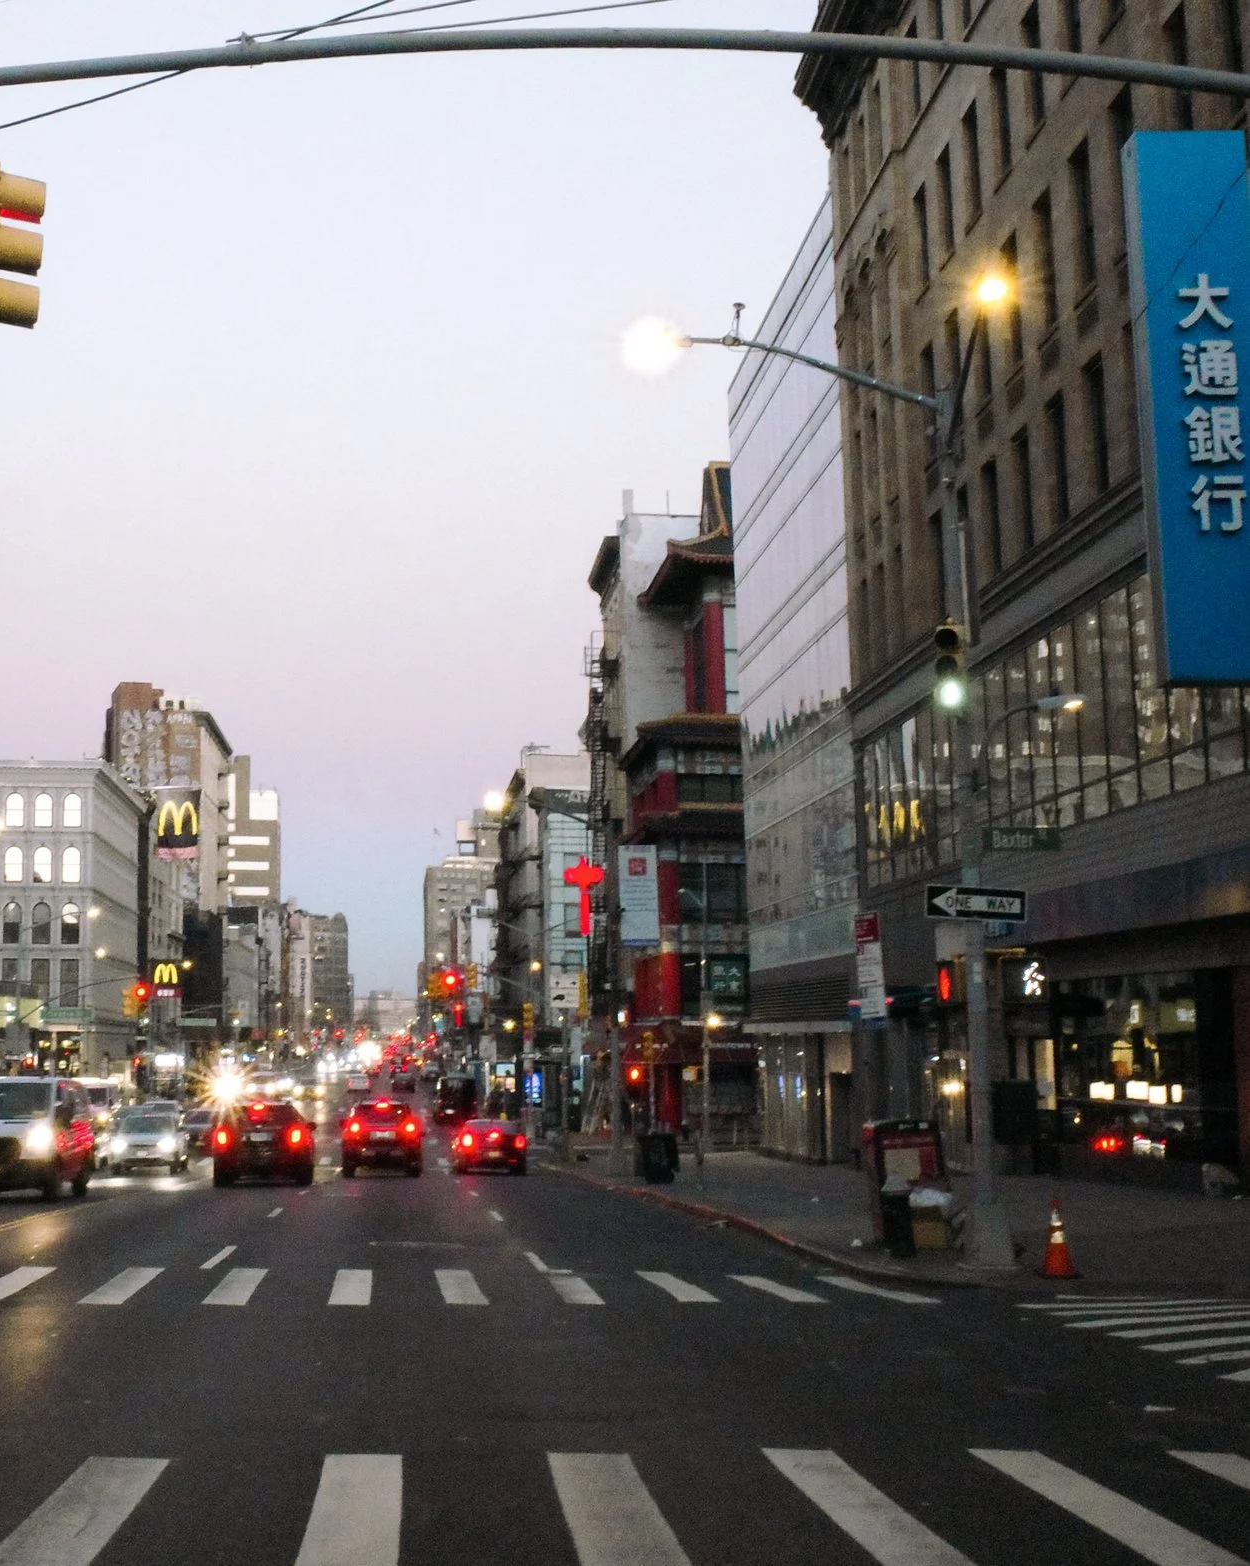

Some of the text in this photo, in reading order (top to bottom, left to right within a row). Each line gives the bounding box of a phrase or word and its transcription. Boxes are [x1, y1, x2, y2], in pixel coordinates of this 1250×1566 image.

[1176, 272, 1248, 533] 大通銀行
[992, 829, 1035, 849] Baxter
[944, 895, 1016, 912] ONE WAY
